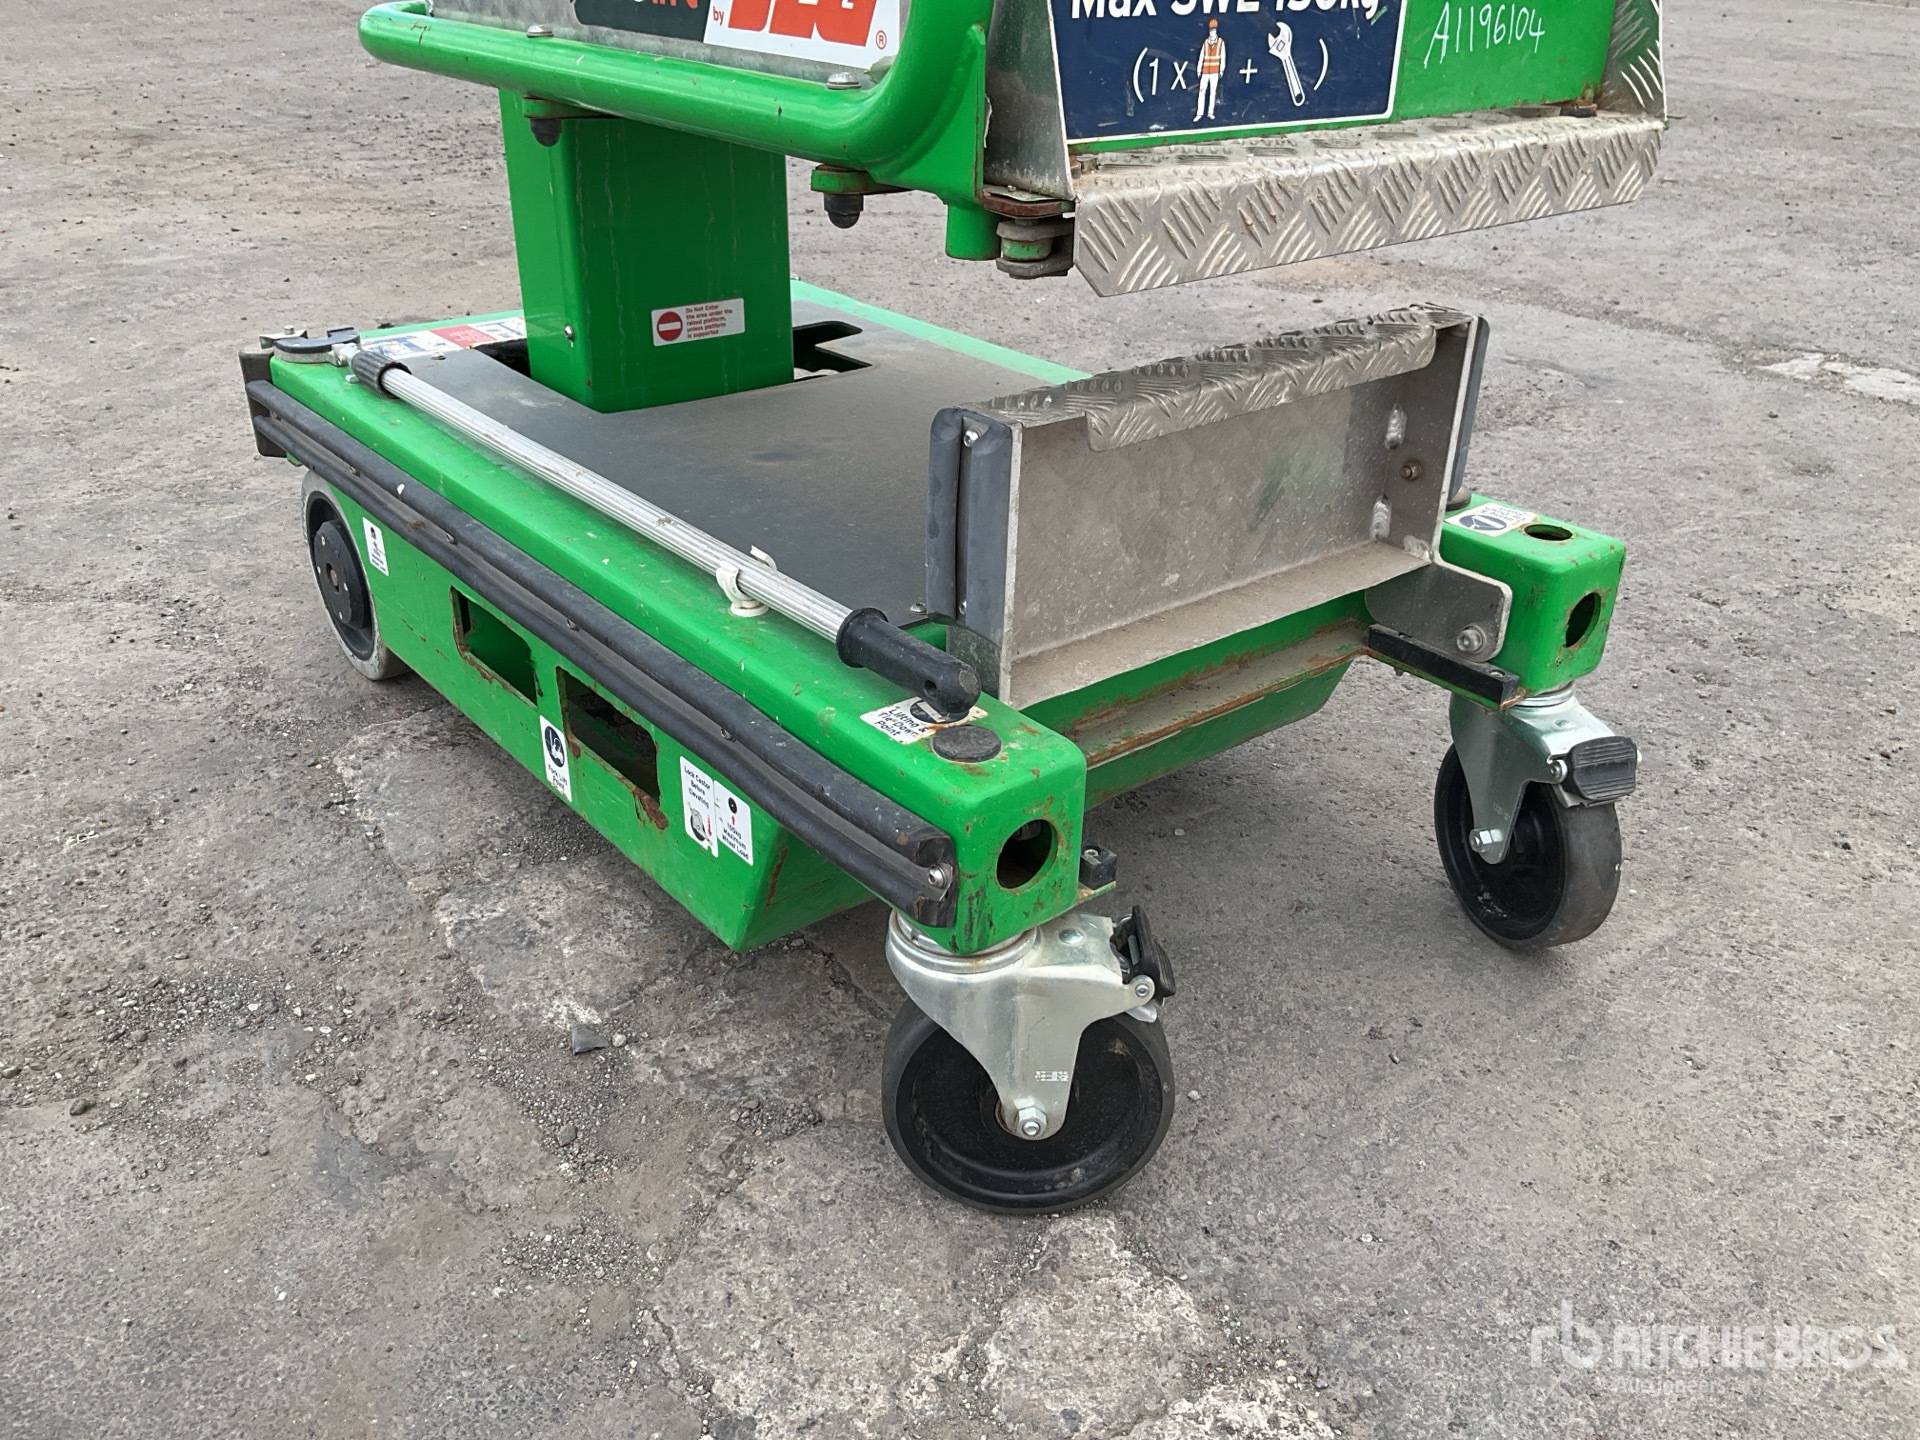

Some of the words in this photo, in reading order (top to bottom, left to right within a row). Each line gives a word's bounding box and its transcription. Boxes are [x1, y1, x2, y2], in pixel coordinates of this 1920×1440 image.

[712, 6, 725, 25] by
[1424, 2, 1545, 69] A1196104
[694, 305, 704, 313] Not
[888, 708, 920, 729] Lifting
[875, 720, 901, 737] Point
